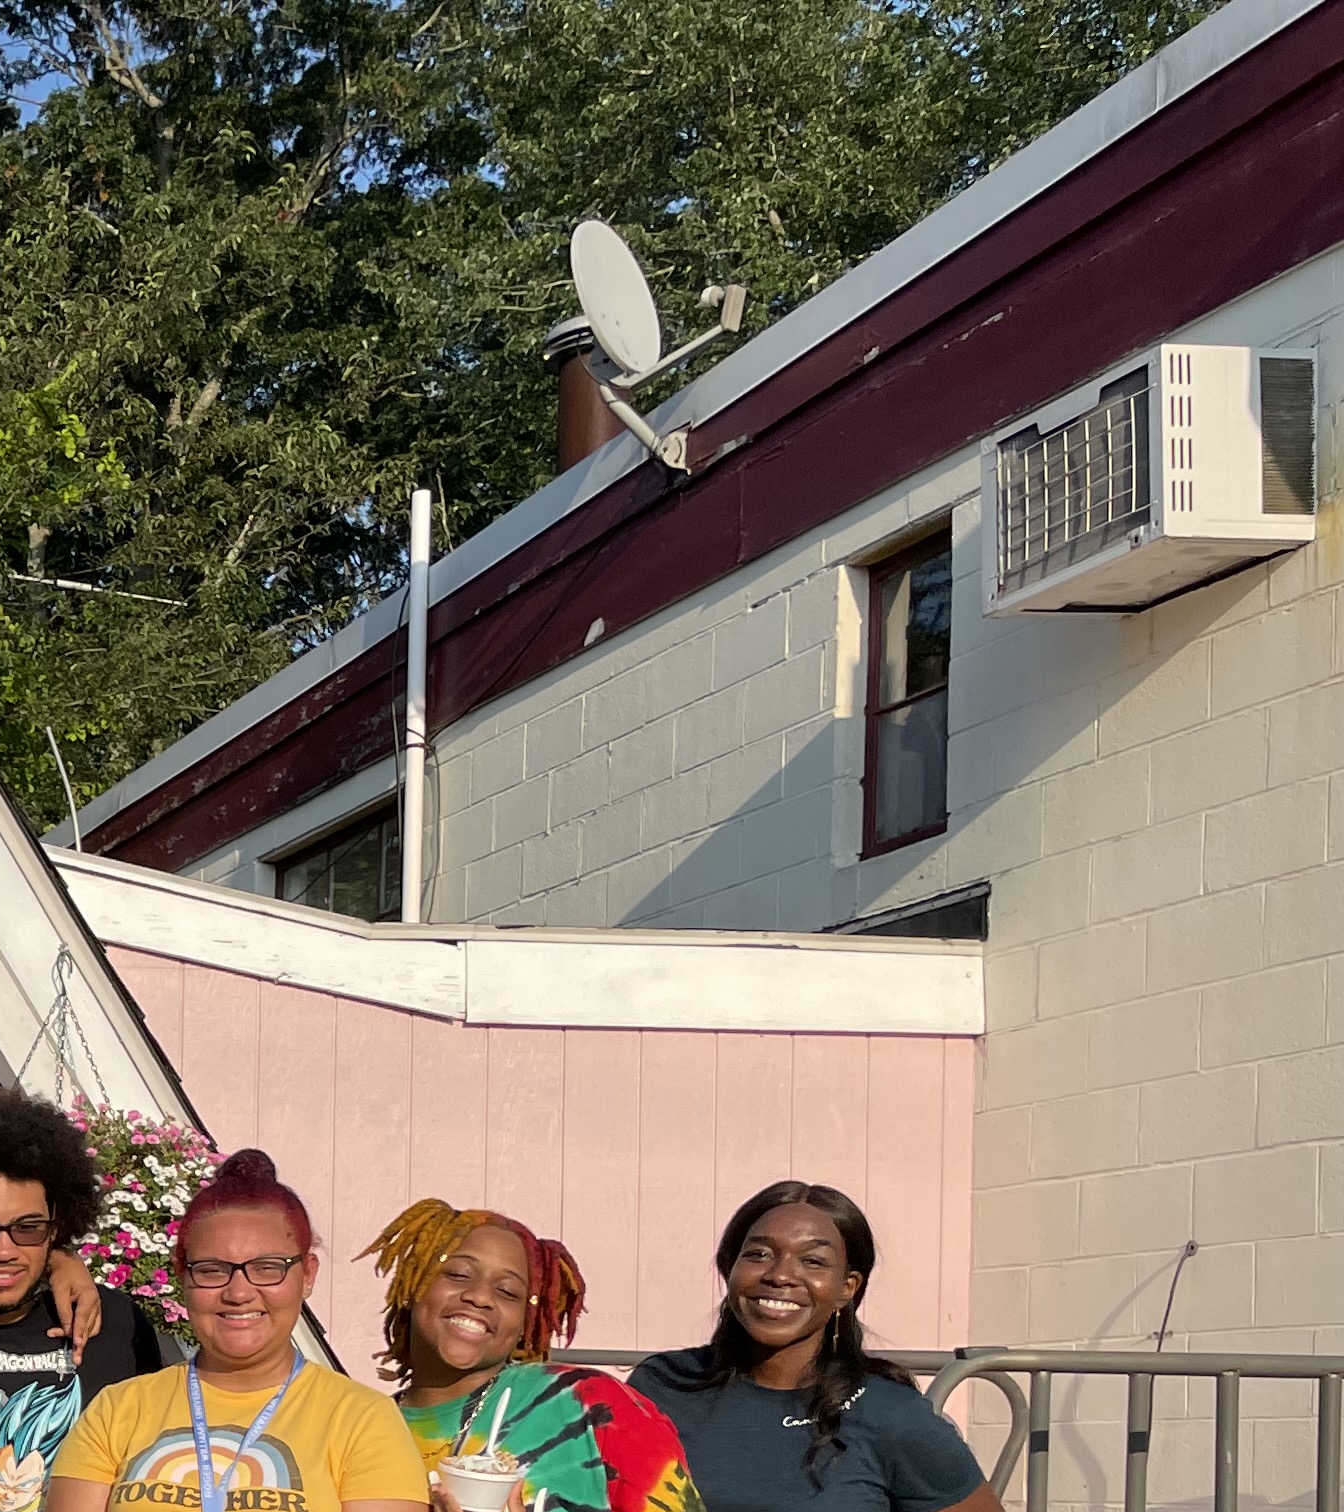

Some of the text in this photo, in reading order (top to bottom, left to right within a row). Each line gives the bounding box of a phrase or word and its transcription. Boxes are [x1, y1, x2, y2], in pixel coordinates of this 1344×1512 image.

[189, 1373, 213, 1498] ROGER WILLIAMS UNIVERSITY
